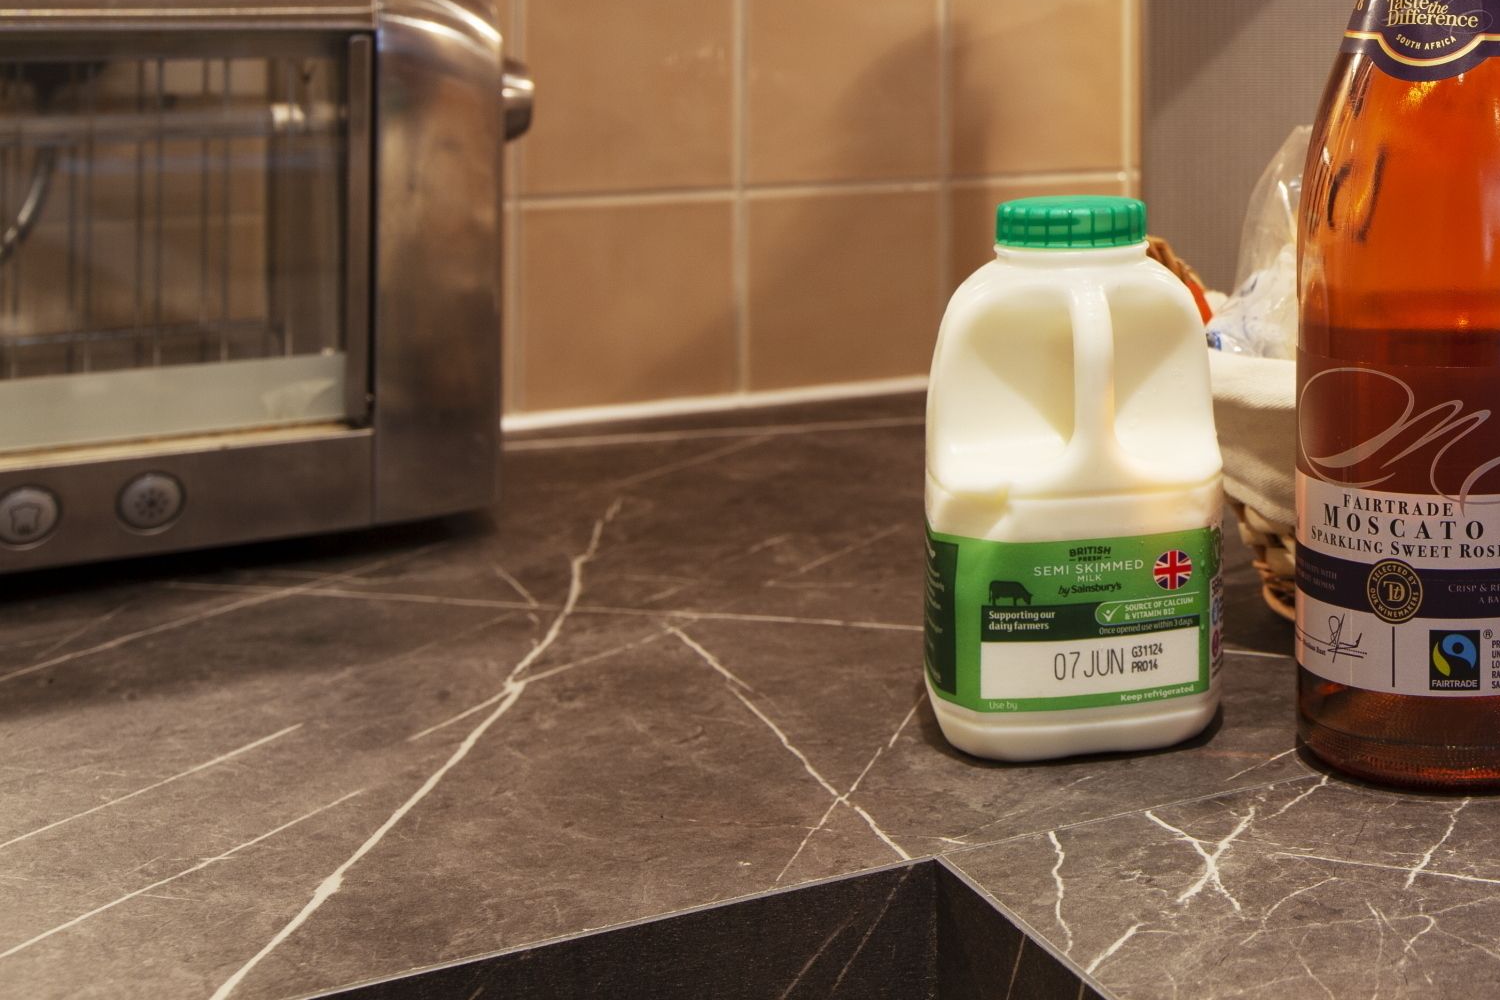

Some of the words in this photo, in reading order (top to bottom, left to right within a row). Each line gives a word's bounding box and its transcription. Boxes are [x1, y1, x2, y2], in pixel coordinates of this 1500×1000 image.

[1427, 1, 1448, 14] the
[1386, 8, 1478, 28] Difference
[1396, 34, 1420, 50] SOUTH
[1424, 36, 1456, 50] AFRICA
[1343, 494, 1453, 516] FAIRTRADE
[1323, 503, 1484, 540] MOSCATO
[1311, 525, 1383, 554] SPARKLING
[1390, 541, 1452, 558] SWEET
[1069, 546, 1111, 557] BRITISH
[1033, 566, 1069, 577] SEMI
[1075, 559, 1144, 574] SKIMMED
[1372, 565, 1408, 581] SELECTED
[1408, 575, 1417, 585] BY
[1077, 574, 1102, 582] MILK
[1058, 586, 1071, 597] by
[1071, 582, 1122, 594] Sainsbury's
[1448, 584, 1477, 593] CRISP
[1479, 584, 1487, 592] &
[1124, 602, 1149, 611] SOURCE
[1163, 597, 1194, 607] CALCIUM
[1370, 588, 1378, 603] OUR
[1378, 592, 1419, 618] WINEMAKERS
[988, 610, 1038, 621] Supporting
[1040, 611, 1056, 619] our
[1131, 610, 1161, 619] VITAMIN
[1163, 607, 1175, 615] B12
[988, 622, 1012, 633] dairy
[1014, 622, 1049, 630] farmers
[1099, 626, 1115, 635] Once
[1116, 624, 1140, 634] opened
[1142, 623, 1152, 631] use
[1153, 620, 1173, 629] within
[1178, 617, 1193, 627] days
[1054, 652, 1080, 680] 07
[1083, 648, 1124, 678] JUN
[1431, 680, 1478, 688] FAIRTRADE
[1492, 681, 1500, 689] SA
[1121, 693, 1142, 702] Keep
[1144, 684, 1194, 700] refrigerated
[988, 701, 1004, 710] Use
[1005, 702, 1018, 711] by
